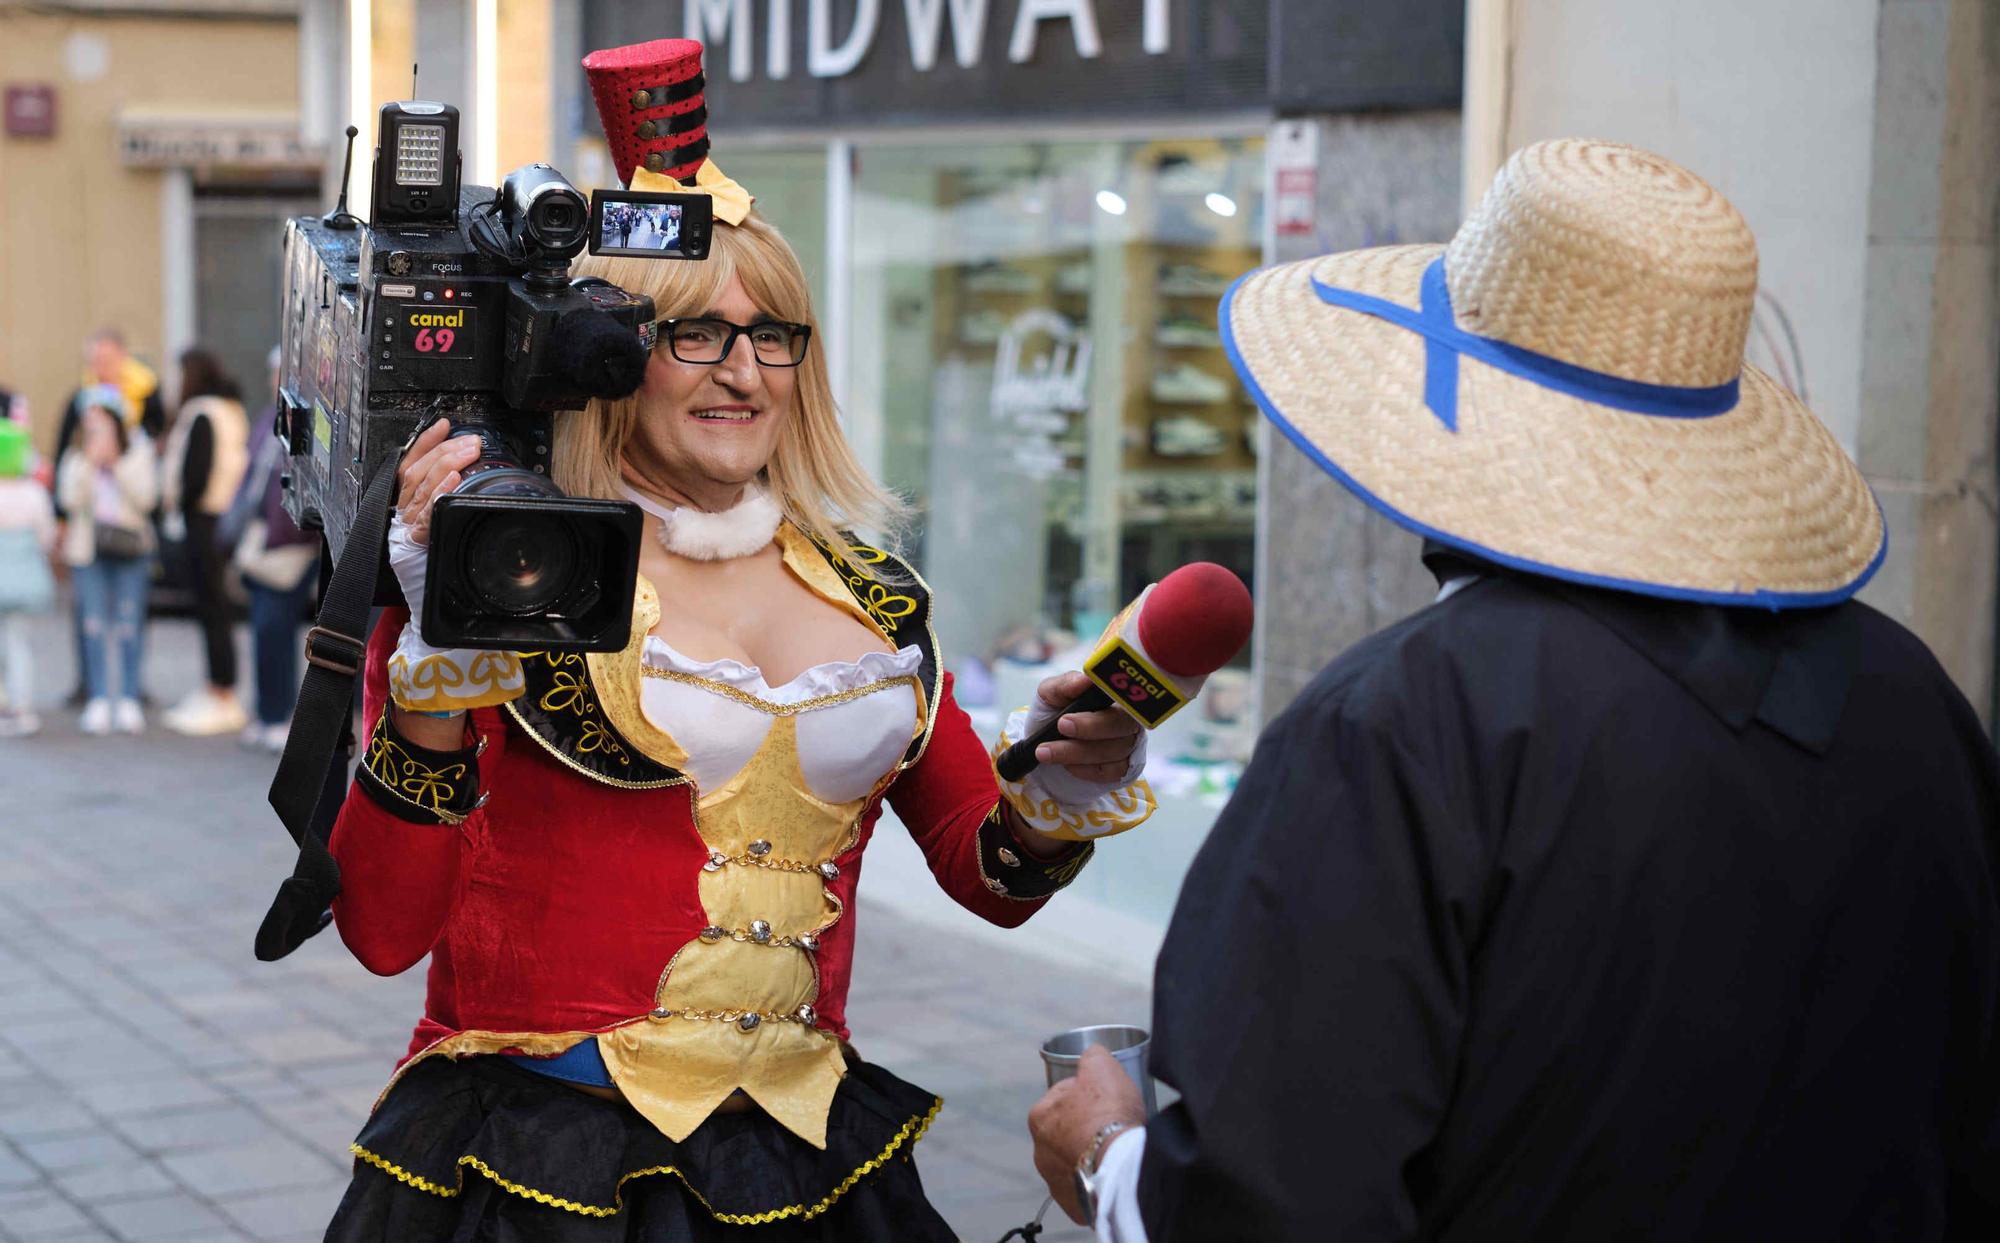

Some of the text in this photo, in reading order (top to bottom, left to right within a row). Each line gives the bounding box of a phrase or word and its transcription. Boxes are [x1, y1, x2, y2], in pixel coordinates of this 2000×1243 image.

[432, 262, 463, 272] FOCUS
[409, 309, 464, 328] canal
[415, 328, 456, 353] 69
[1109, 672, 1149, 702] 69
[1117, 657, 1168, 700] canal
